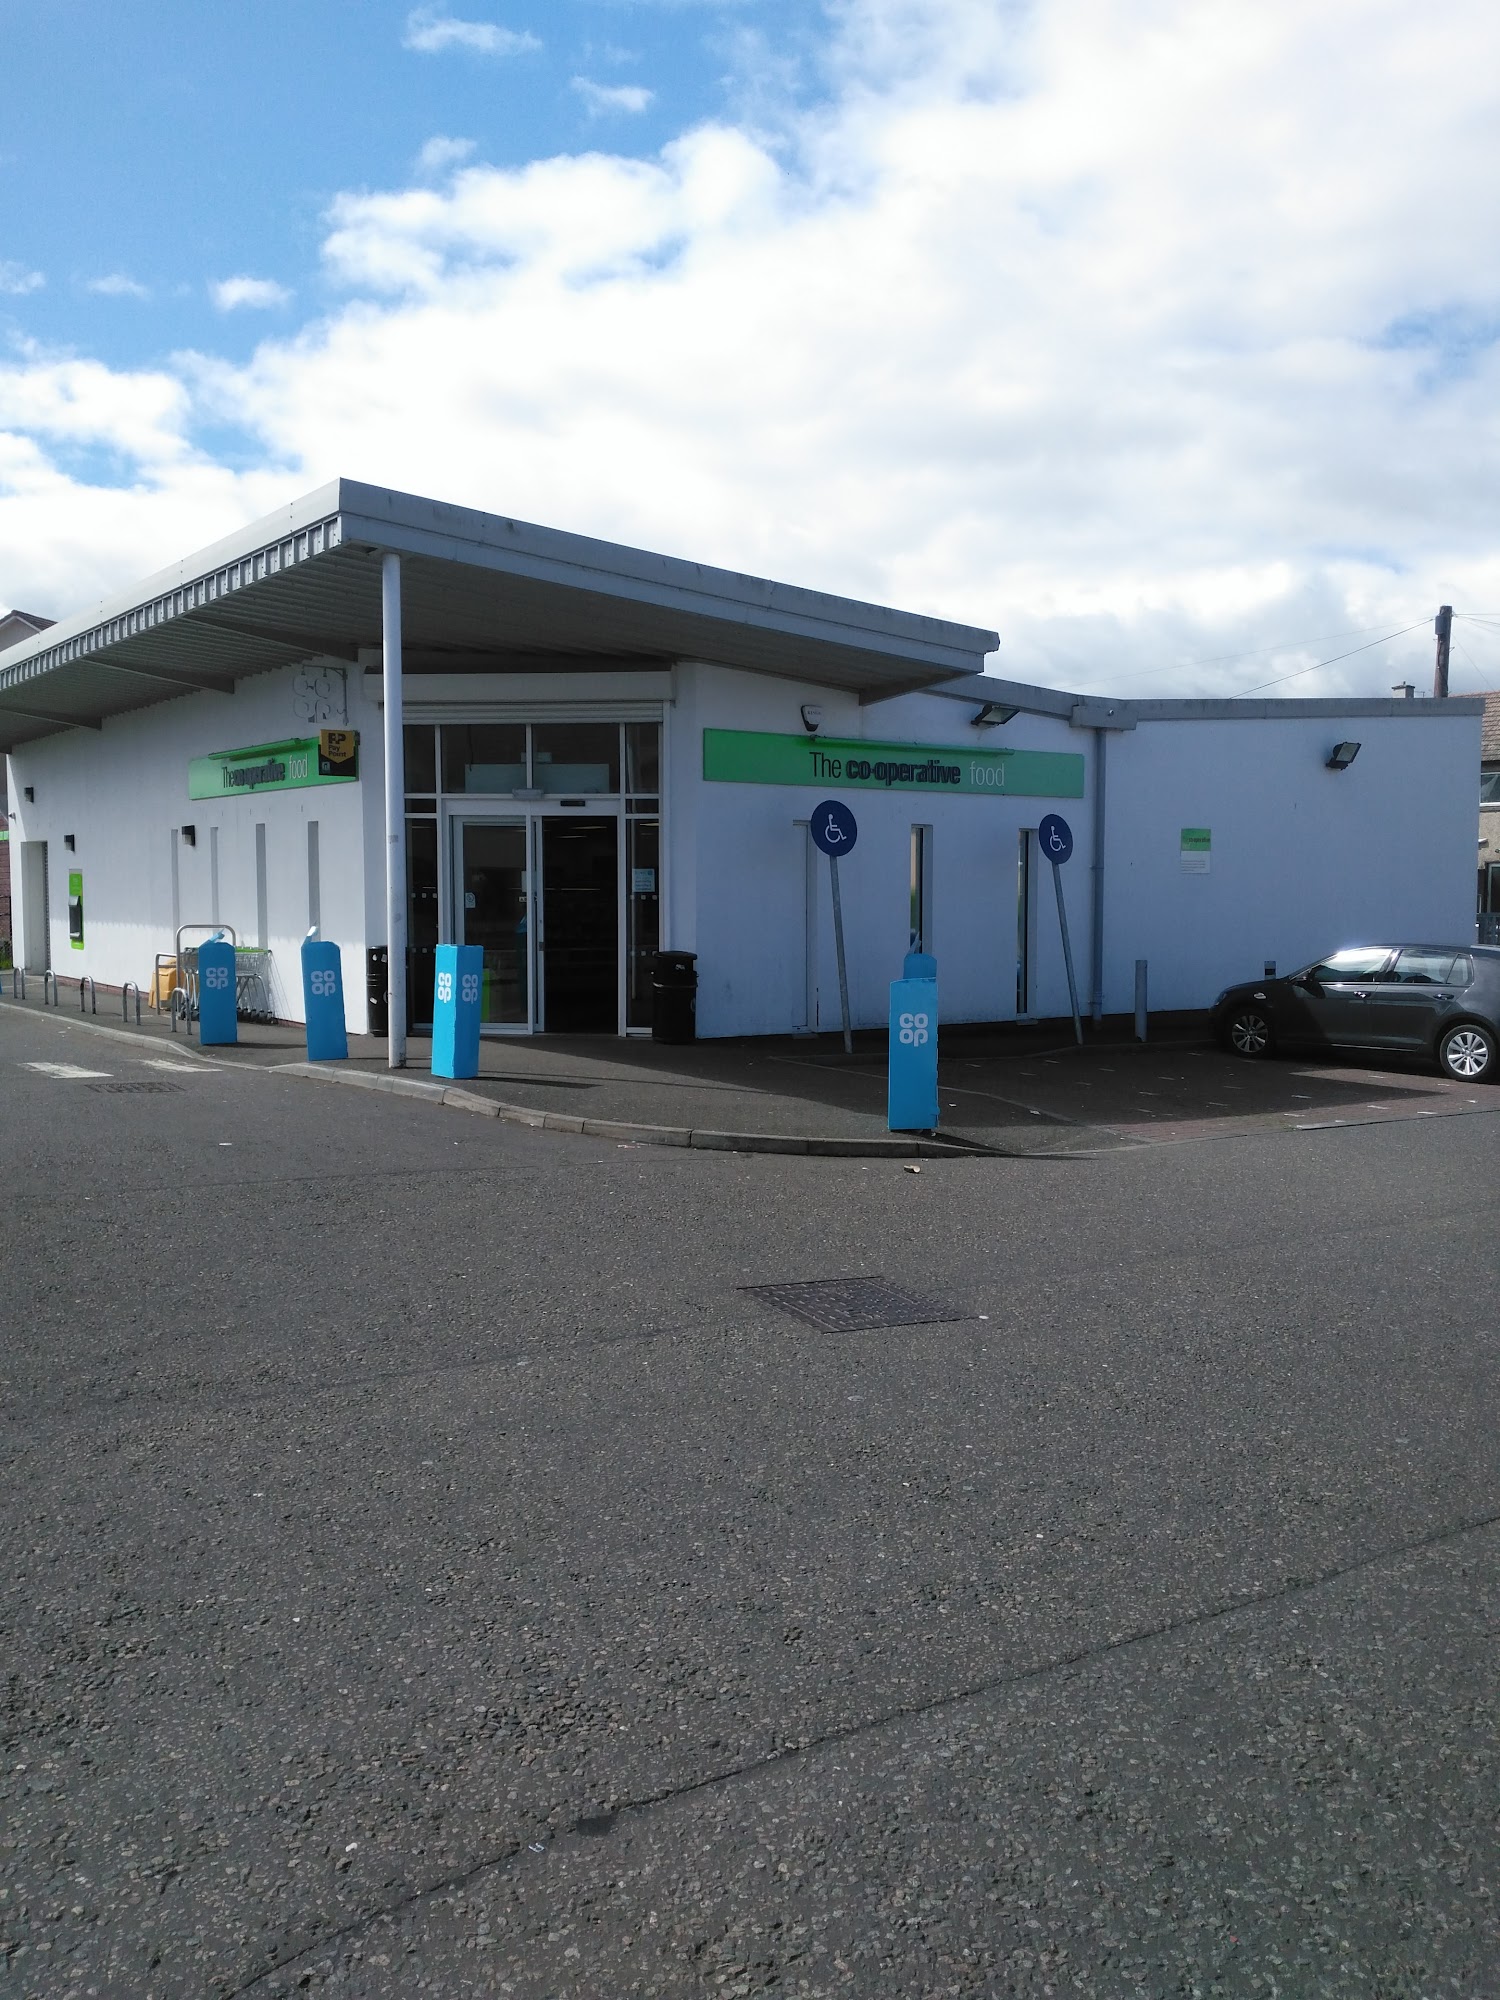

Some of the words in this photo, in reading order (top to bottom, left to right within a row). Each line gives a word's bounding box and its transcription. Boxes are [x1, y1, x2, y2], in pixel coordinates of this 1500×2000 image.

[328, 744, 340, 752] Pay
[222, 766, 234, 788] The
[289, 753, 308, 779] food
[809, 752, 842, 778] The
[969, 761, 1005, 786] food
